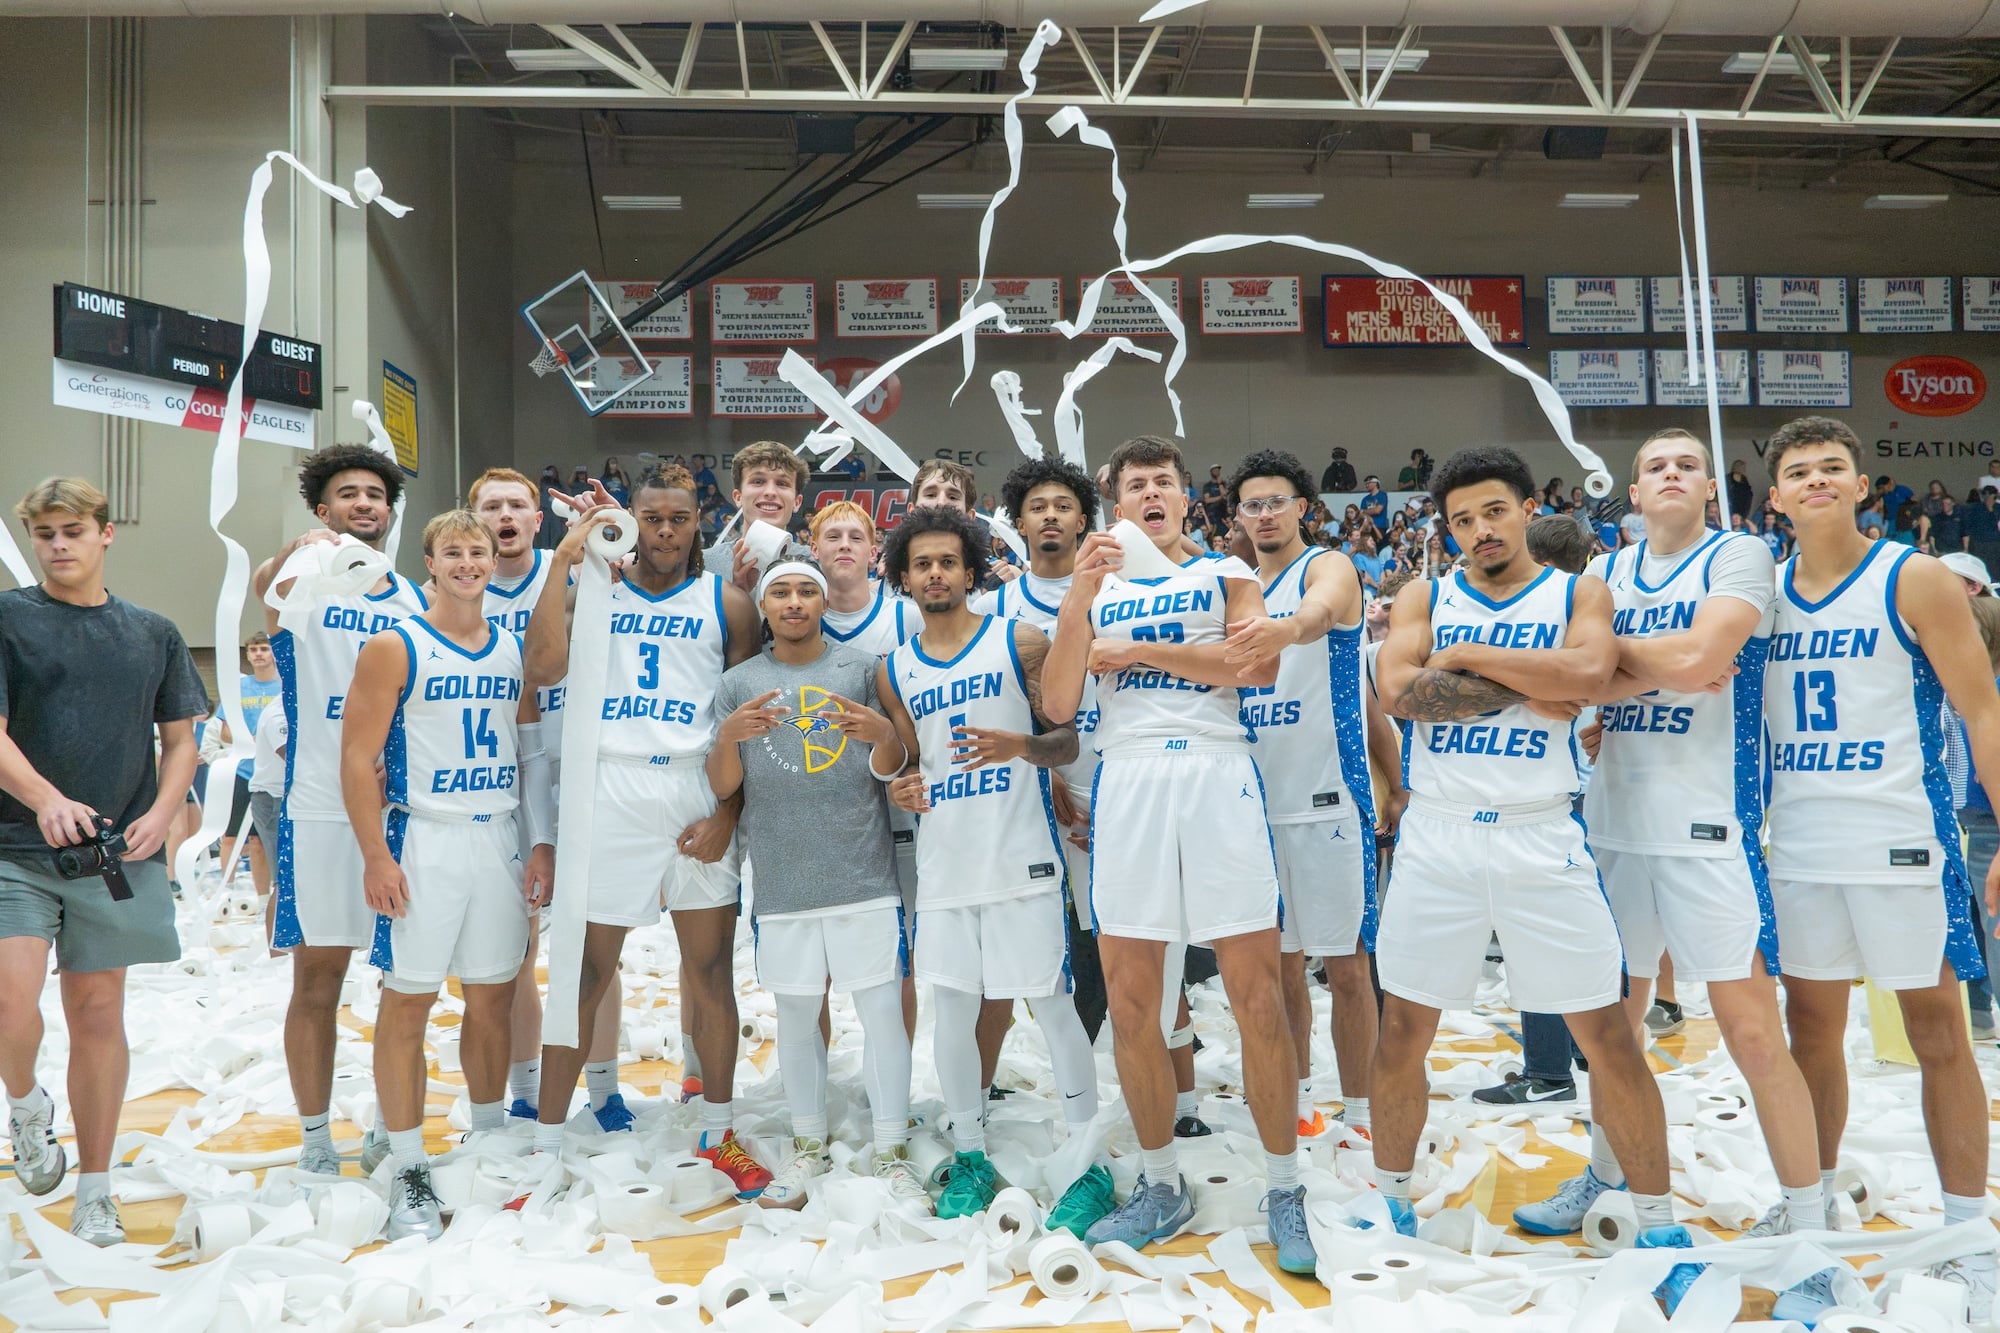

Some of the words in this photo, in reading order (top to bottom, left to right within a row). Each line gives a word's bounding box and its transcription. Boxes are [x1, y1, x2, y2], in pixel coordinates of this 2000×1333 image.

[1376, 280, 1414, 295] 2005
[1577, 280, 1615, 294] NAIA
[1783, 280, 1818, 296] NAIA
[1887, 280, 1921, 295] NAIA
[77, 291, 125, 319] HOME
[851, 312, 924, 320] VOLLEYBALL
[1004, 306, 1047, 314] EYBALL
[1217, 309, 1286, 317] VOLLEYBALL
[1347, 312, 1390, 326] MENS
[1403, 311, 1500, 327] BASKEALL
[1348, 327, 1420, 342] NATIONAL
[271, 338, 314, 363] GUEST
[1580, 353, 1617, 369] NAIA
[173, 358, 209, 377] PERIOD
[68, 378, 149, 404] Generations
[1895, 368, 1974, 402] Tyson
[612, 401, 686, 409] AMPIONS
[720, 395, 808, 403] TOURNAMENT
[165, 397, 186, 410] GO
[190, 401, 249, 423] GOLN
[253, 413, 305, 433] EAGLES!
[1876, 439, 1995, 458] SEATING
[323, 606, 402, 634] GOLD
[1100, 589, 1213, 628] GOLDEN
[1613, 601, 1697, 636] OLDEN
[1436, 622, 1559, 650] GOLDEN
[637, 642, 660, 690] 3
[424, 675, 520, 702] GOLDEN
[909, 672, 1003, 722] GOLDEN
[1793, 670, 1838, 732] 13
[601, 695, 697, 725] EAGLES
[1602, 705, 1695, 734] EAGLES
[462, 707, 498, 759] 14
[1429, 725, 1549, 759] EAGLES
[763, 736, 798, 773] GOLDEN
[1773, 741, 1885, 772] EAGLES
[431, 766, 516, 793] EAGLES
